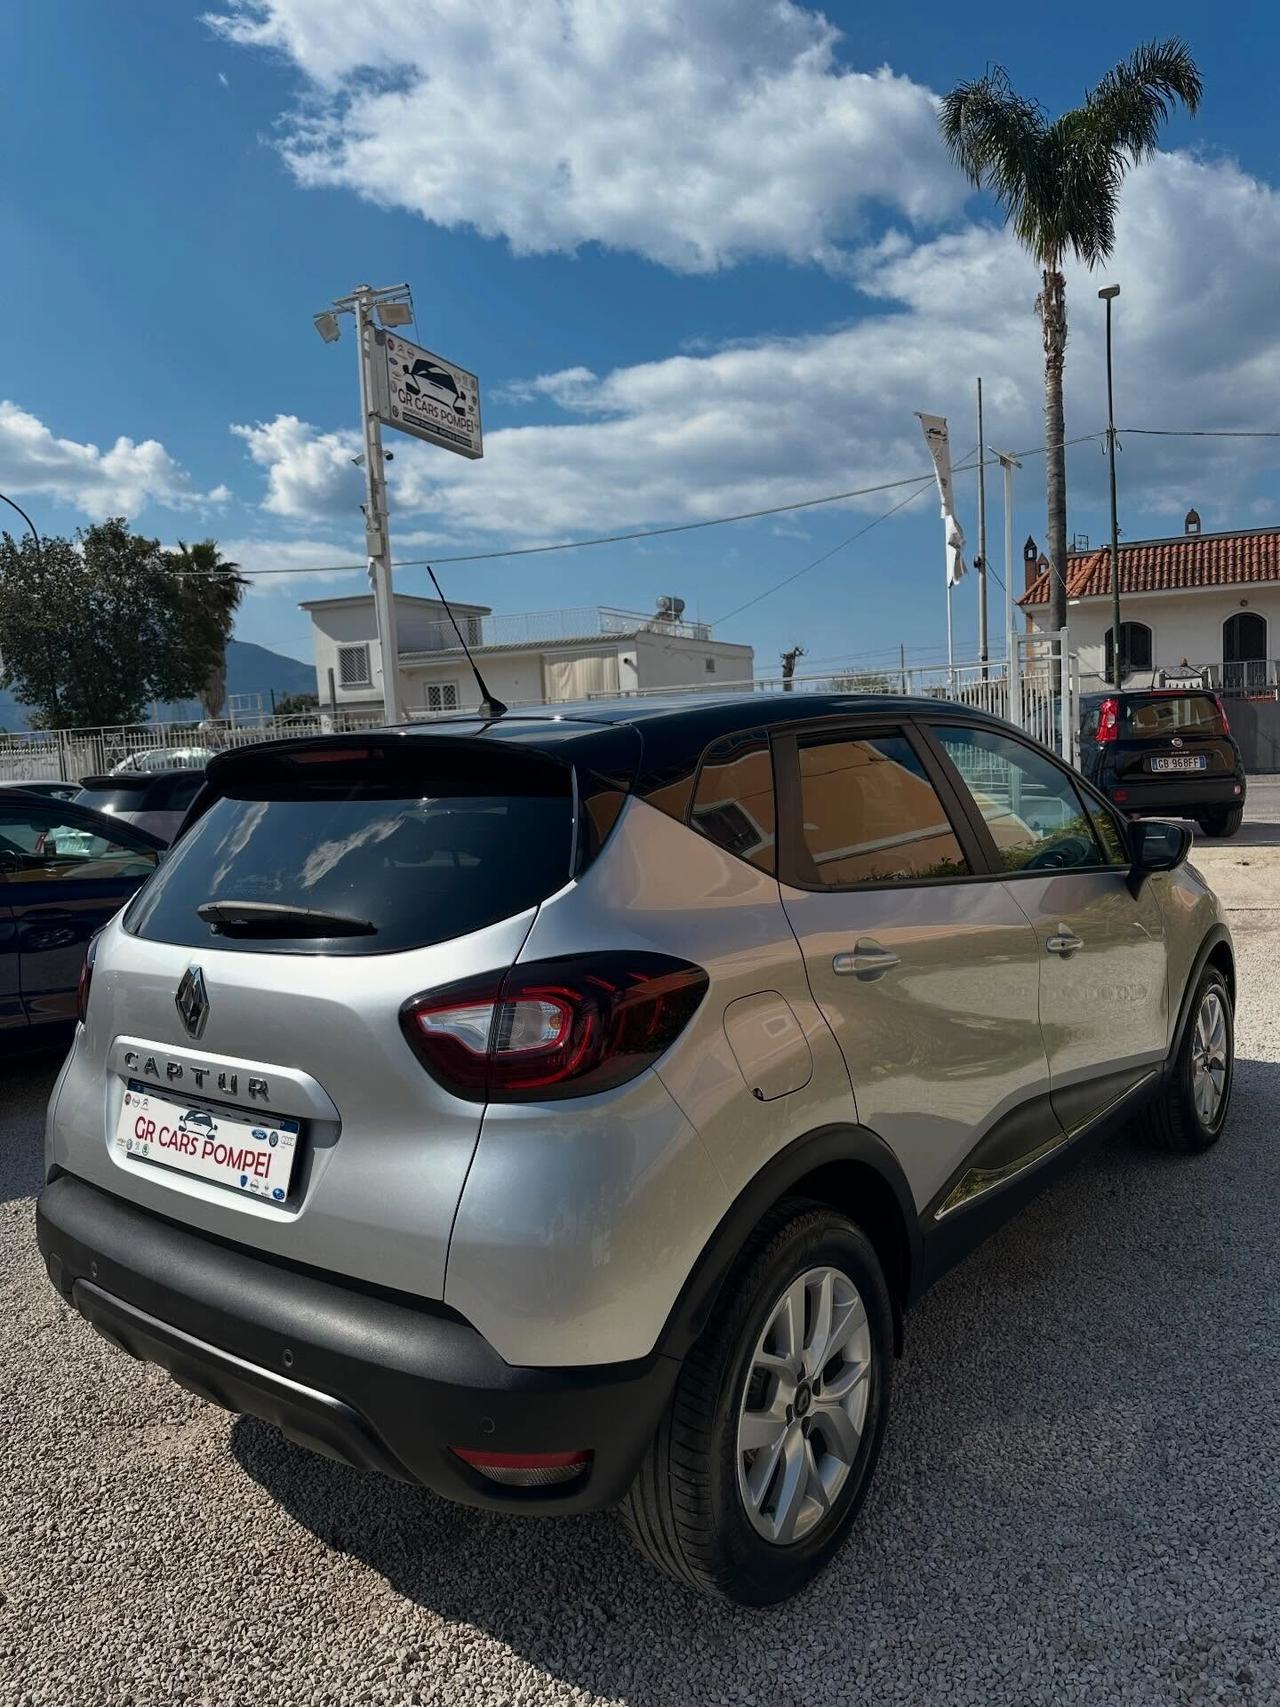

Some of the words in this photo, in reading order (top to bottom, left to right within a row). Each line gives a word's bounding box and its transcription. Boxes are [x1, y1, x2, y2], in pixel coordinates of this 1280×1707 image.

[398, 388, 413, 407] GR
[414, 397, 439, 418] CARS
[441, 411, 475, 433] POMPEI
[124, 1052, 271, 1102] CAPTUR
[134, 1116, 156, 1143] GR
[158, 1126, 199, 1156] CARS
[201, 1140, 272, 1179] POMPEI
